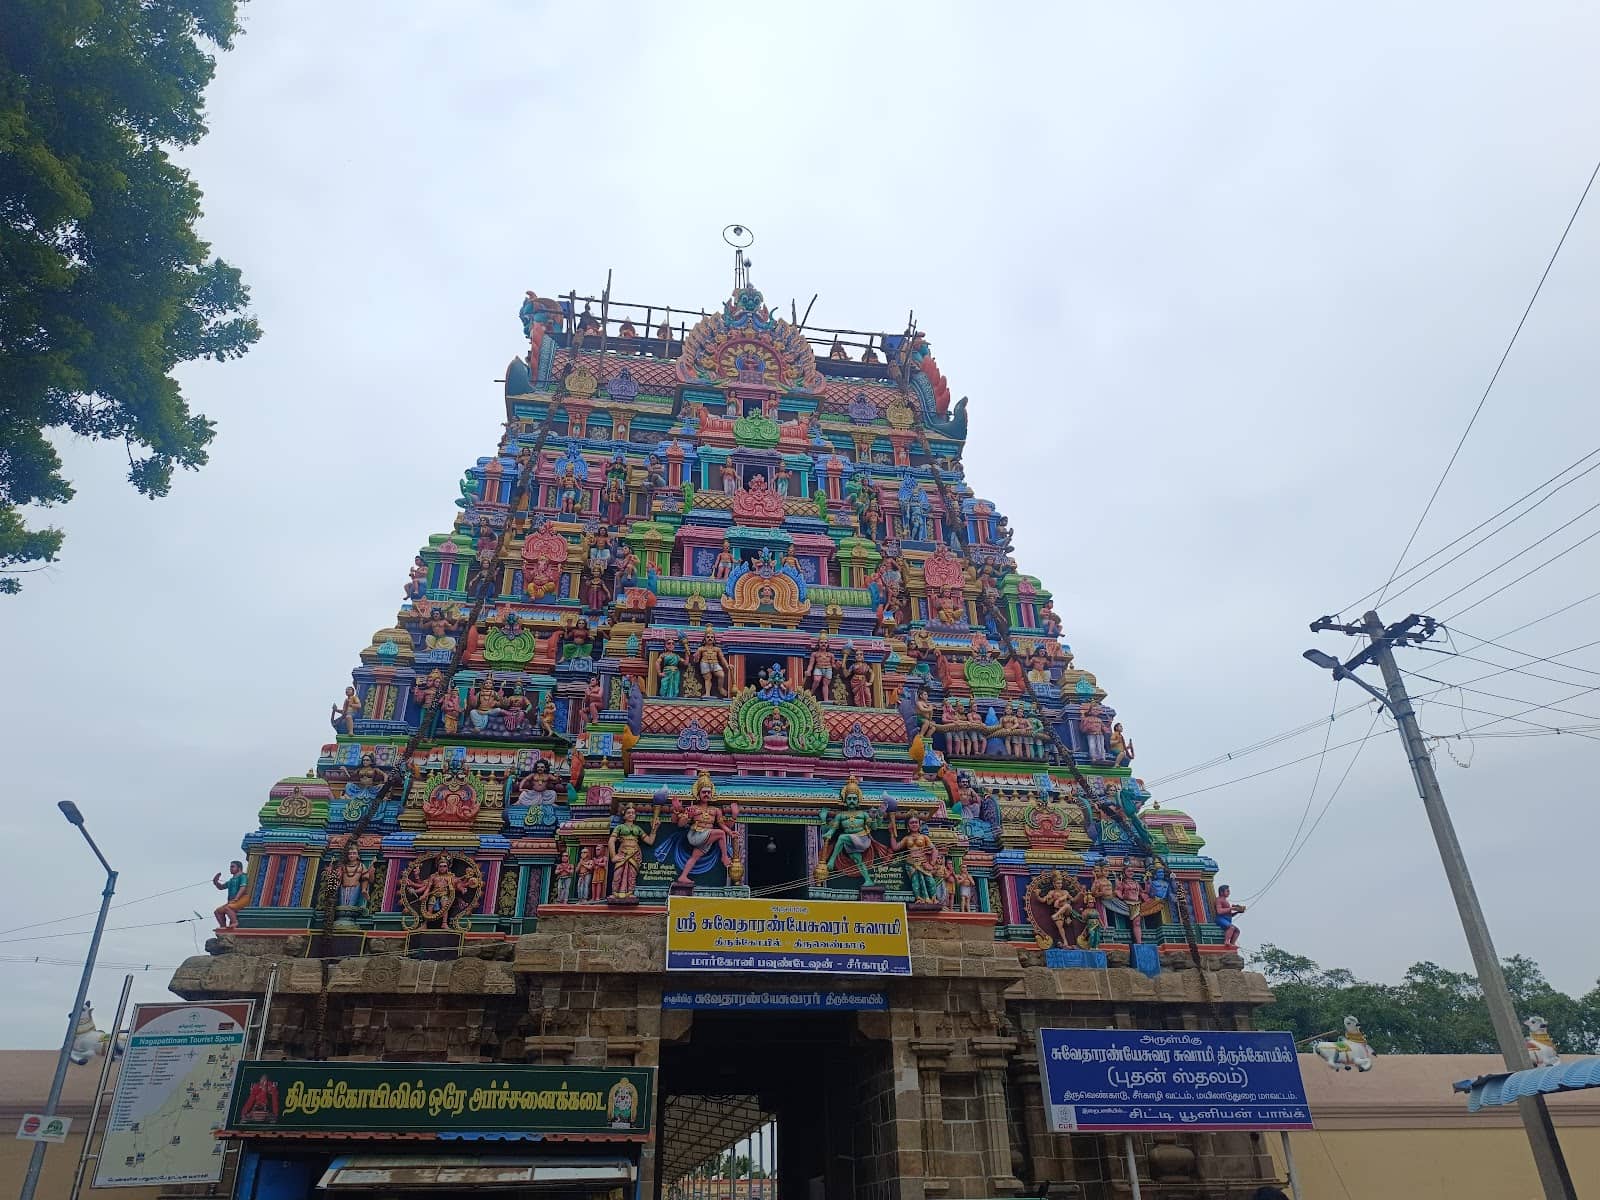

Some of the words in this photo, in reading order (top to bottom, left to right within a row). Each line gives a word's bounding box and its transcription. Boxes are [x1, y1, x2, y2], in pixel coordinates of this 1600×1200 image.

[853, 917, 902, 935] சுவாமி
[691, 956, 754, 968] மார்கோனி
[846, 959, 889, 973] சீர்காழி
[140, 1037, 188, 1045] Nagapattinam
[215, 1034, 235, 1042] Spots
[1140, 1035, 1202, 1045] அருள்மிகு
[1173, 1045, 1215, 1062] சுவாமி
[1217, 1045, 1294, 1065] திருக்கோயில்
[1107, 1066, 1166, 1088] (புதன்
[1172, 1067, 1248, 1088] ஸ்தலம்)
[282, 1078, 427, 1117] திருக்கோயிலில்
[428, 1082, 467, 1117] ஒரே
[469, 1080, 606, 1112] அர்ச்சனைக்கடை
[1063, 1090, 1131, 1101] திருவெண்காடு,
[1132, 1090, 1163, 1101] சீர்காழி
[1165, 1090, 1194, 1100] வட்டம்,
[1196, 1091, 1257, 1102] மயிலாடுதுறை
[1258, 1091, 1298, 1100] மாவட்டம்.
[1129, 1108, 1174, 1121] சிட்டி
[1178, 1108, 1252, 1122] யூனியன்
[1257, 1108, 1305, 1119] பாங்க்
